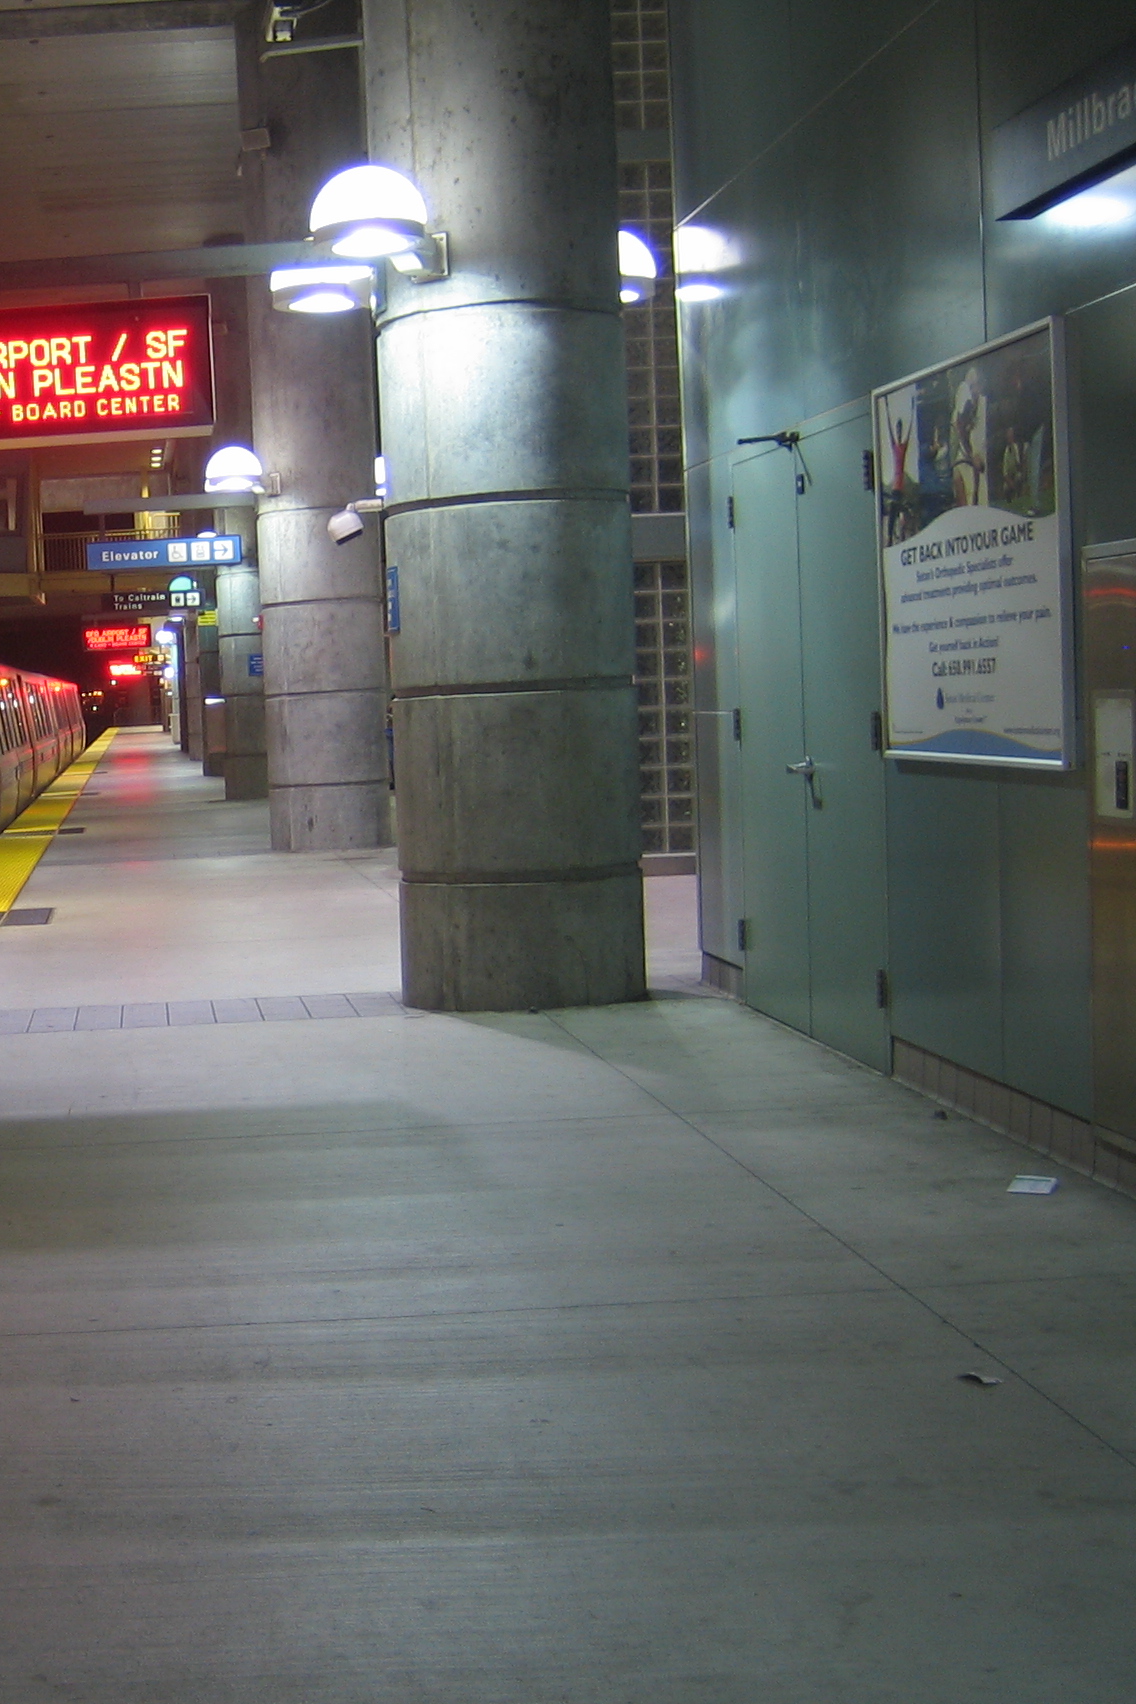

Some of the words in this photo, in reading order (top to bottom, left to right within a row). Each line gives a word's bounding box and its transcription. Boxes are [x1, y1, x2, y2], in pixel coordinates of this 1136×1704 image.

[1047, 80, 1136, 161] Millbra
[111, 333, 128, 361] /
[145, 329, 188, 359] SF
[32, 360, 184, 397] PLEASTN
[12, 400, 87, 422] BOARD
[97, 394, 181, 415] CENTER
[900, 547, 917, 566] GET
[919, 541, 943, 562] BACK
[945, 535, 969, 557] INTO
[969, 529, 998, 550] YOUR
[1000, 521, 1034, 545] GAME
[102, 549, 159, 562] Elevator
[114, 594, 124, 602] To
[128, 592, 166, 602] Caltrain
[114, 602, 143, 611] Trains
[1018, 609, 1034, 623] your
[134, 655, 154, 664] EXIT
